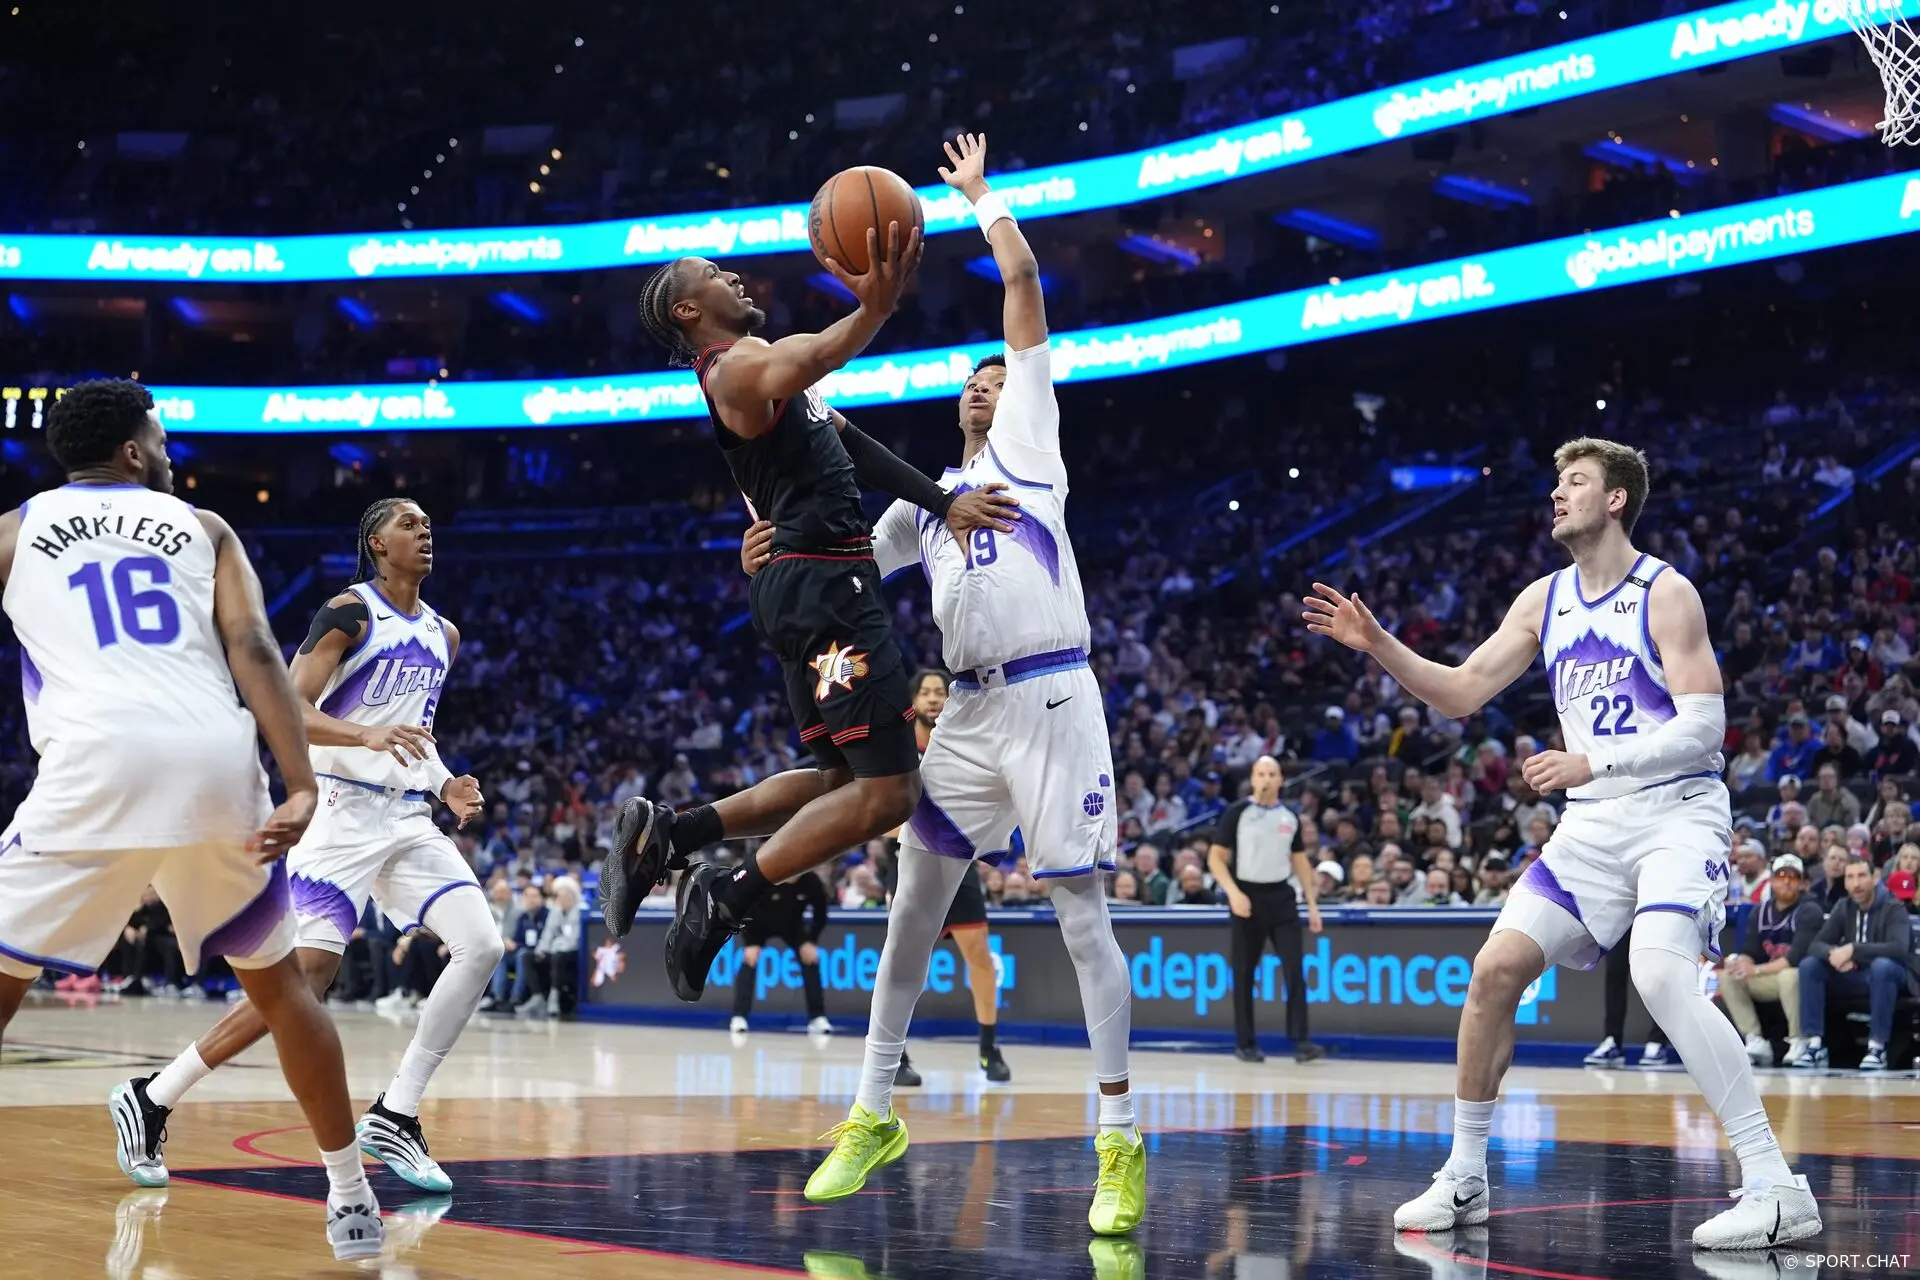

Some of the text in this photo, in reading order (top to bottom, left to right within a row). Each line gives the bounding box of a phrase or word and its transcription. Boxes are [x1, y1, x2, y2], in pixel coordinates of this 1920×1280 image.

[1566, 208, 1815, 288] globalpayments
[31, 515, 192, 560] HARKLESS
[67, 554, 181, 649] 16
[361, 658, 446, 707] UTAH
[1554, 655, 1639, 714] UTAH
[1591, 695, 1638, 736] 22
